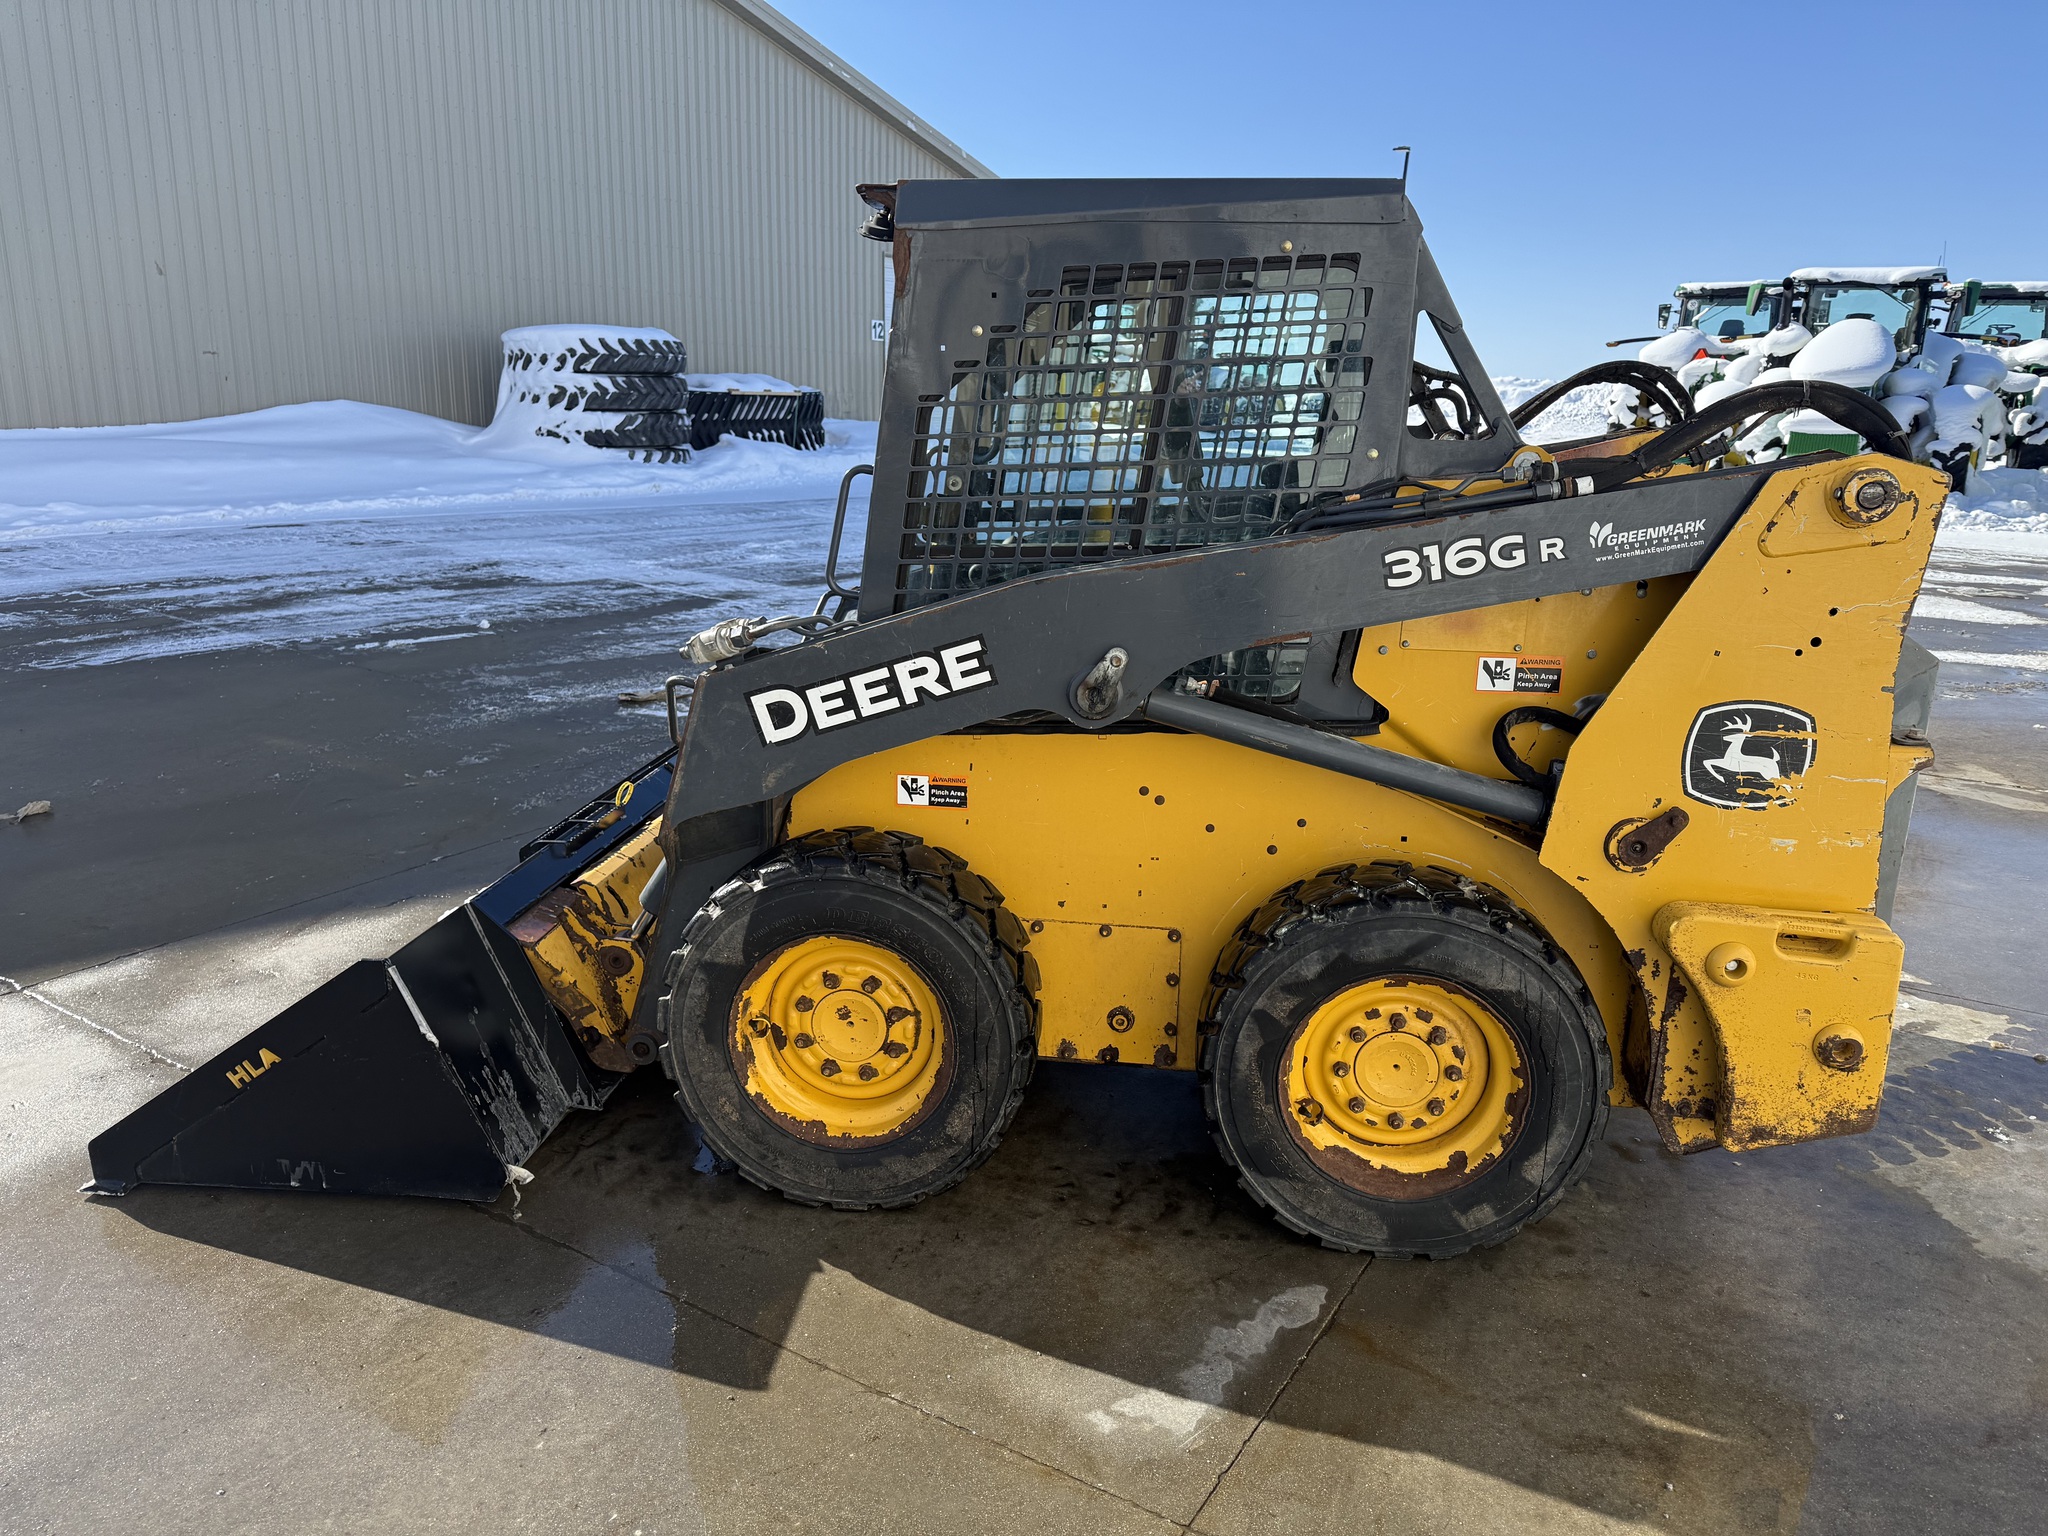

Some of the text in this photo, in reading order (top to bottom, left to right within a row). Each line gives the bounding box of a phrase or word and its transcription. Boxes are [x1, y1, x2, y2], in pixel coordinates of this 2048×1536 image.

[873, 322, 884, 339] 12
[1607, 518, 1707, 546] GREENMARK
[1614, 532, 1699, 551] EQUIPMENT
[1384, 534, 1566, 588] 316G R
[1595, 539, 1705, 562] www.GreenMarkEquipment.com
[1527, 658, 1561, 666] WARNING
[1518, 672, 1538, 680] Pinch
[1534, 681, 1552, 689] Away
[749, 640, 992, 744] DEERE
[225, 1047, 283, 1090] HLA
